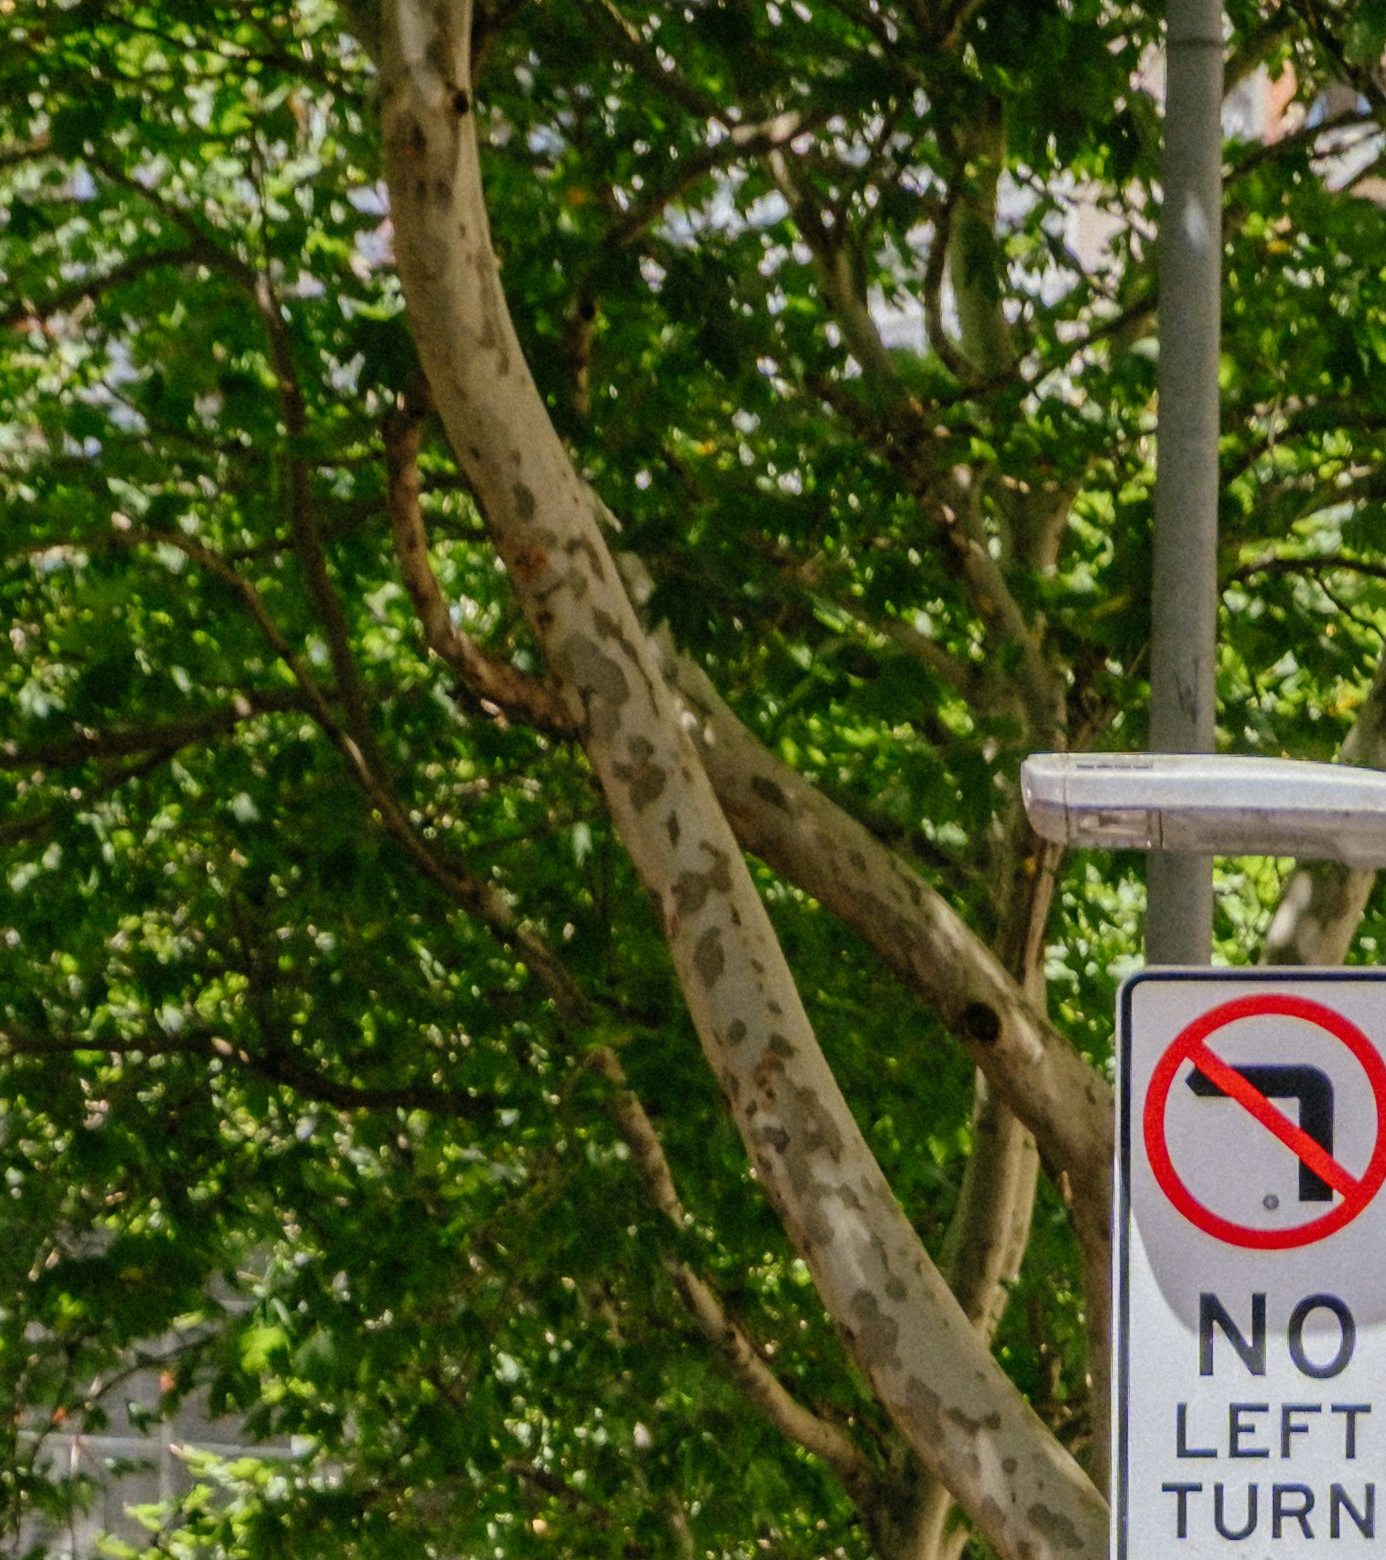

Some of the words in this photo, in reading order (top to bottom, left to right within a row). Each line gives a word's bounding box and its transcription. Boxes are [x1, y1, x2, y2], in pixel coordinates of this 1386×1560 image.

[1198, 1292, 1357, 1379] NO
[1176, 1402, 1373, 1460] LEFT
[1161, 1482, 1377, 1541] TURN
